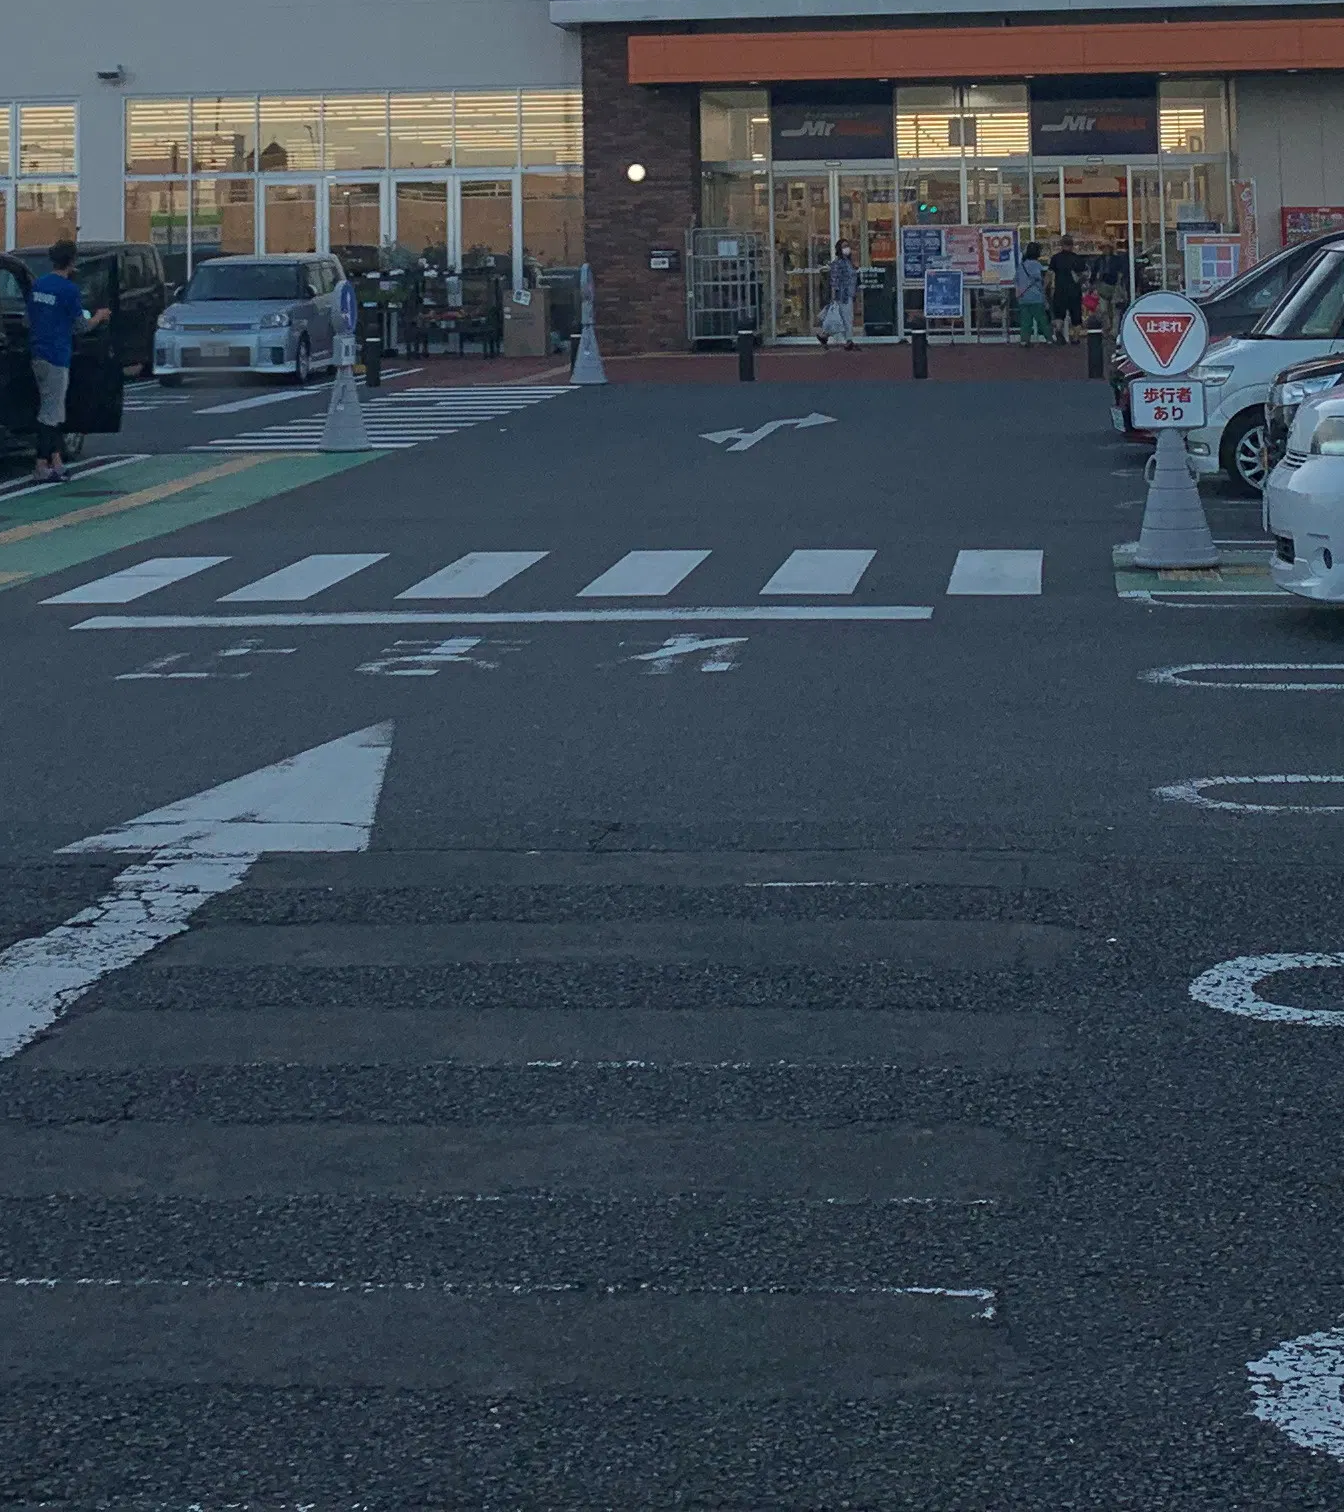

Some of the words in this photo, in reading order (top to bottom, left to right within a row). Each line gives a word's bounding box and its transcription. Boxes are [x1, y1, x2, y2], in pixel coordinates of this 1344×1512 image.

[1146, 320, 1183, 333] 止まれ
[1143, 387, 1192, 403] 歩行者
[1153, 405, 1184, 421] あり
